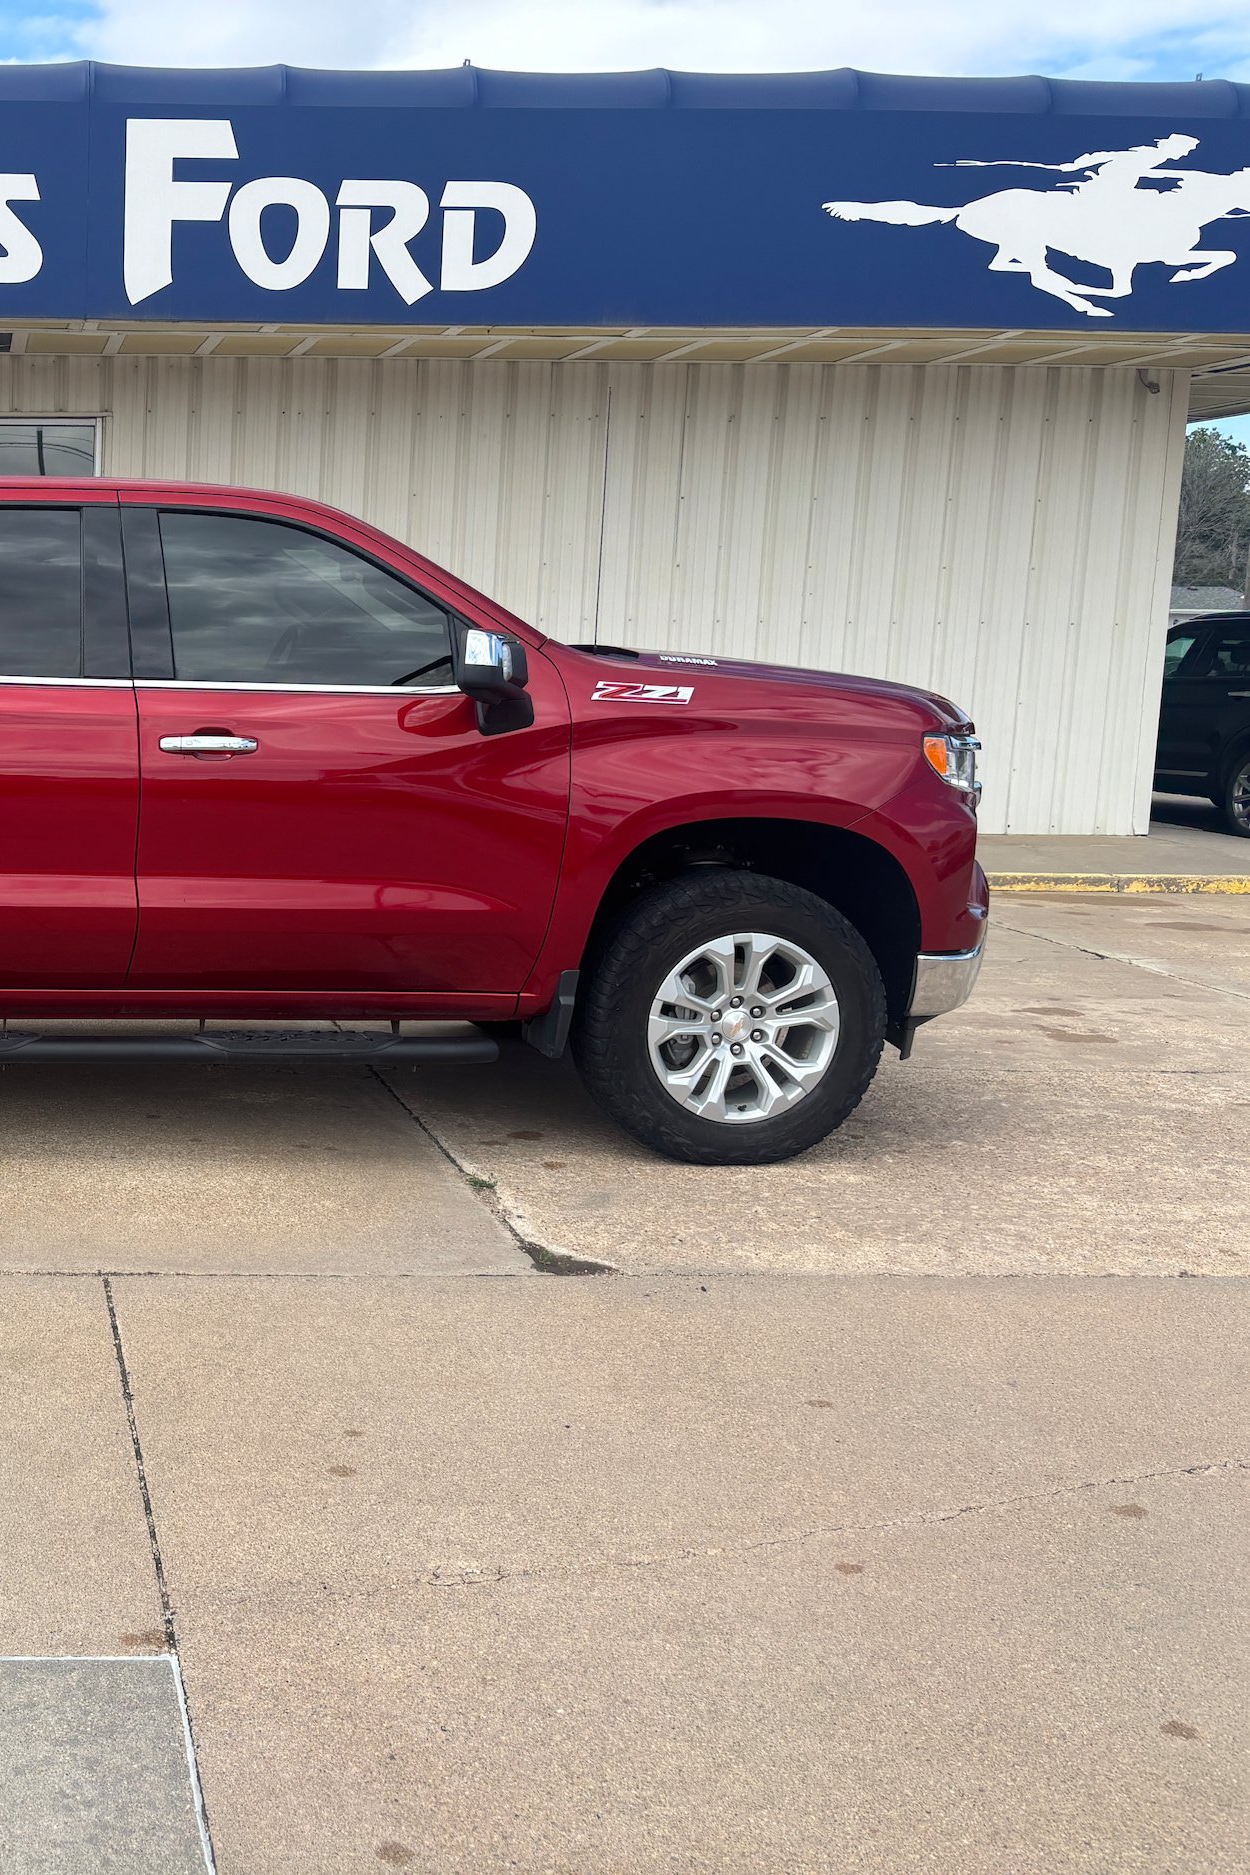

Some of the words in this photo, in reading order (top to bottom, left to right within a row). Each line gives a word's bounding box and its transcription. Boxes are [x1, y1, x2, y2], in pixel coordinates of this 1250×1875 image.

[123, 118, 537, 306] FORD
[659, 655, 718, 666] DURAMAX
[590, 681, 695, 704] Z71
